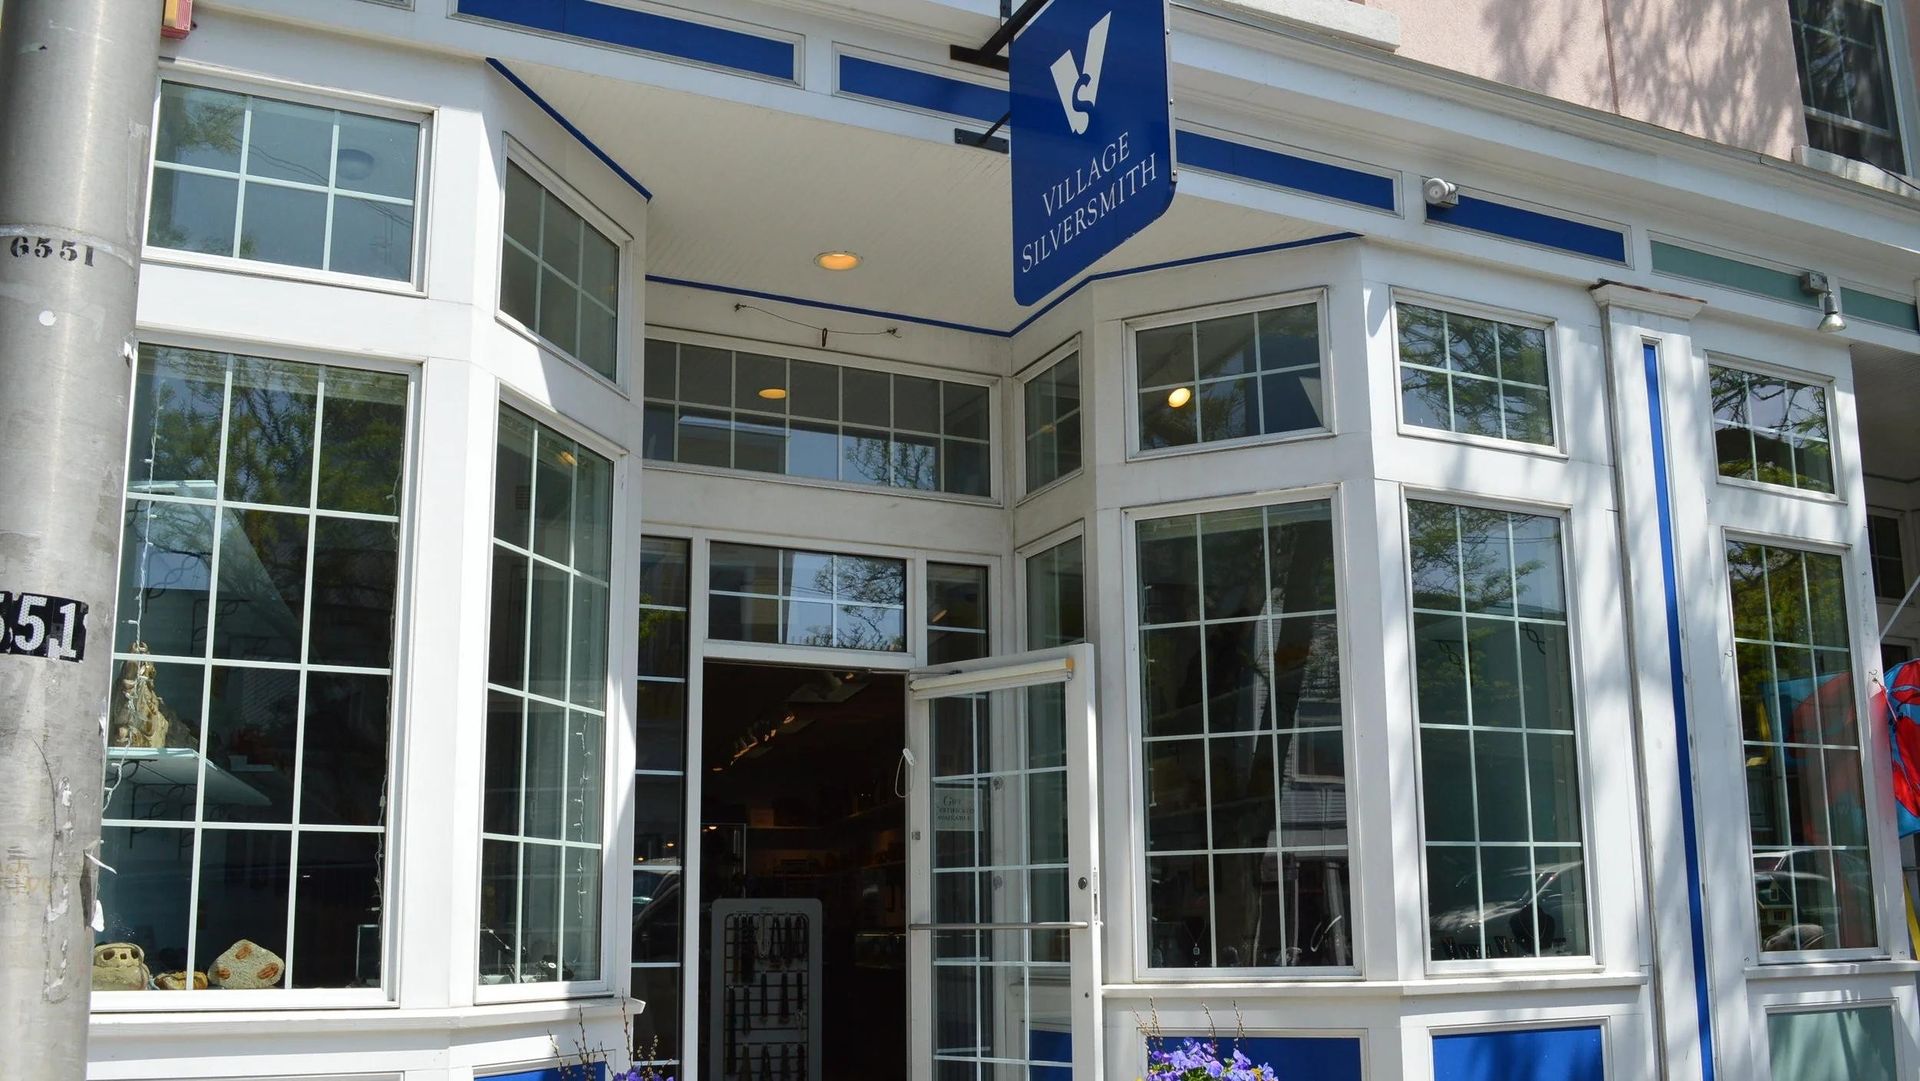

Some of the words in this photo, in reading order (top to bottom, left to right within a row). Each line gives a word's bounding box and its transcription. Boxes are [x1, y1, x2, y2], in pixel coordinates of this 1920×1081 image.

[1022, 152, 1158, 273] SILVERSMITH
[1042, 131, 1131, 217] VILLAGE
[0, 593, 77, 658] 51
